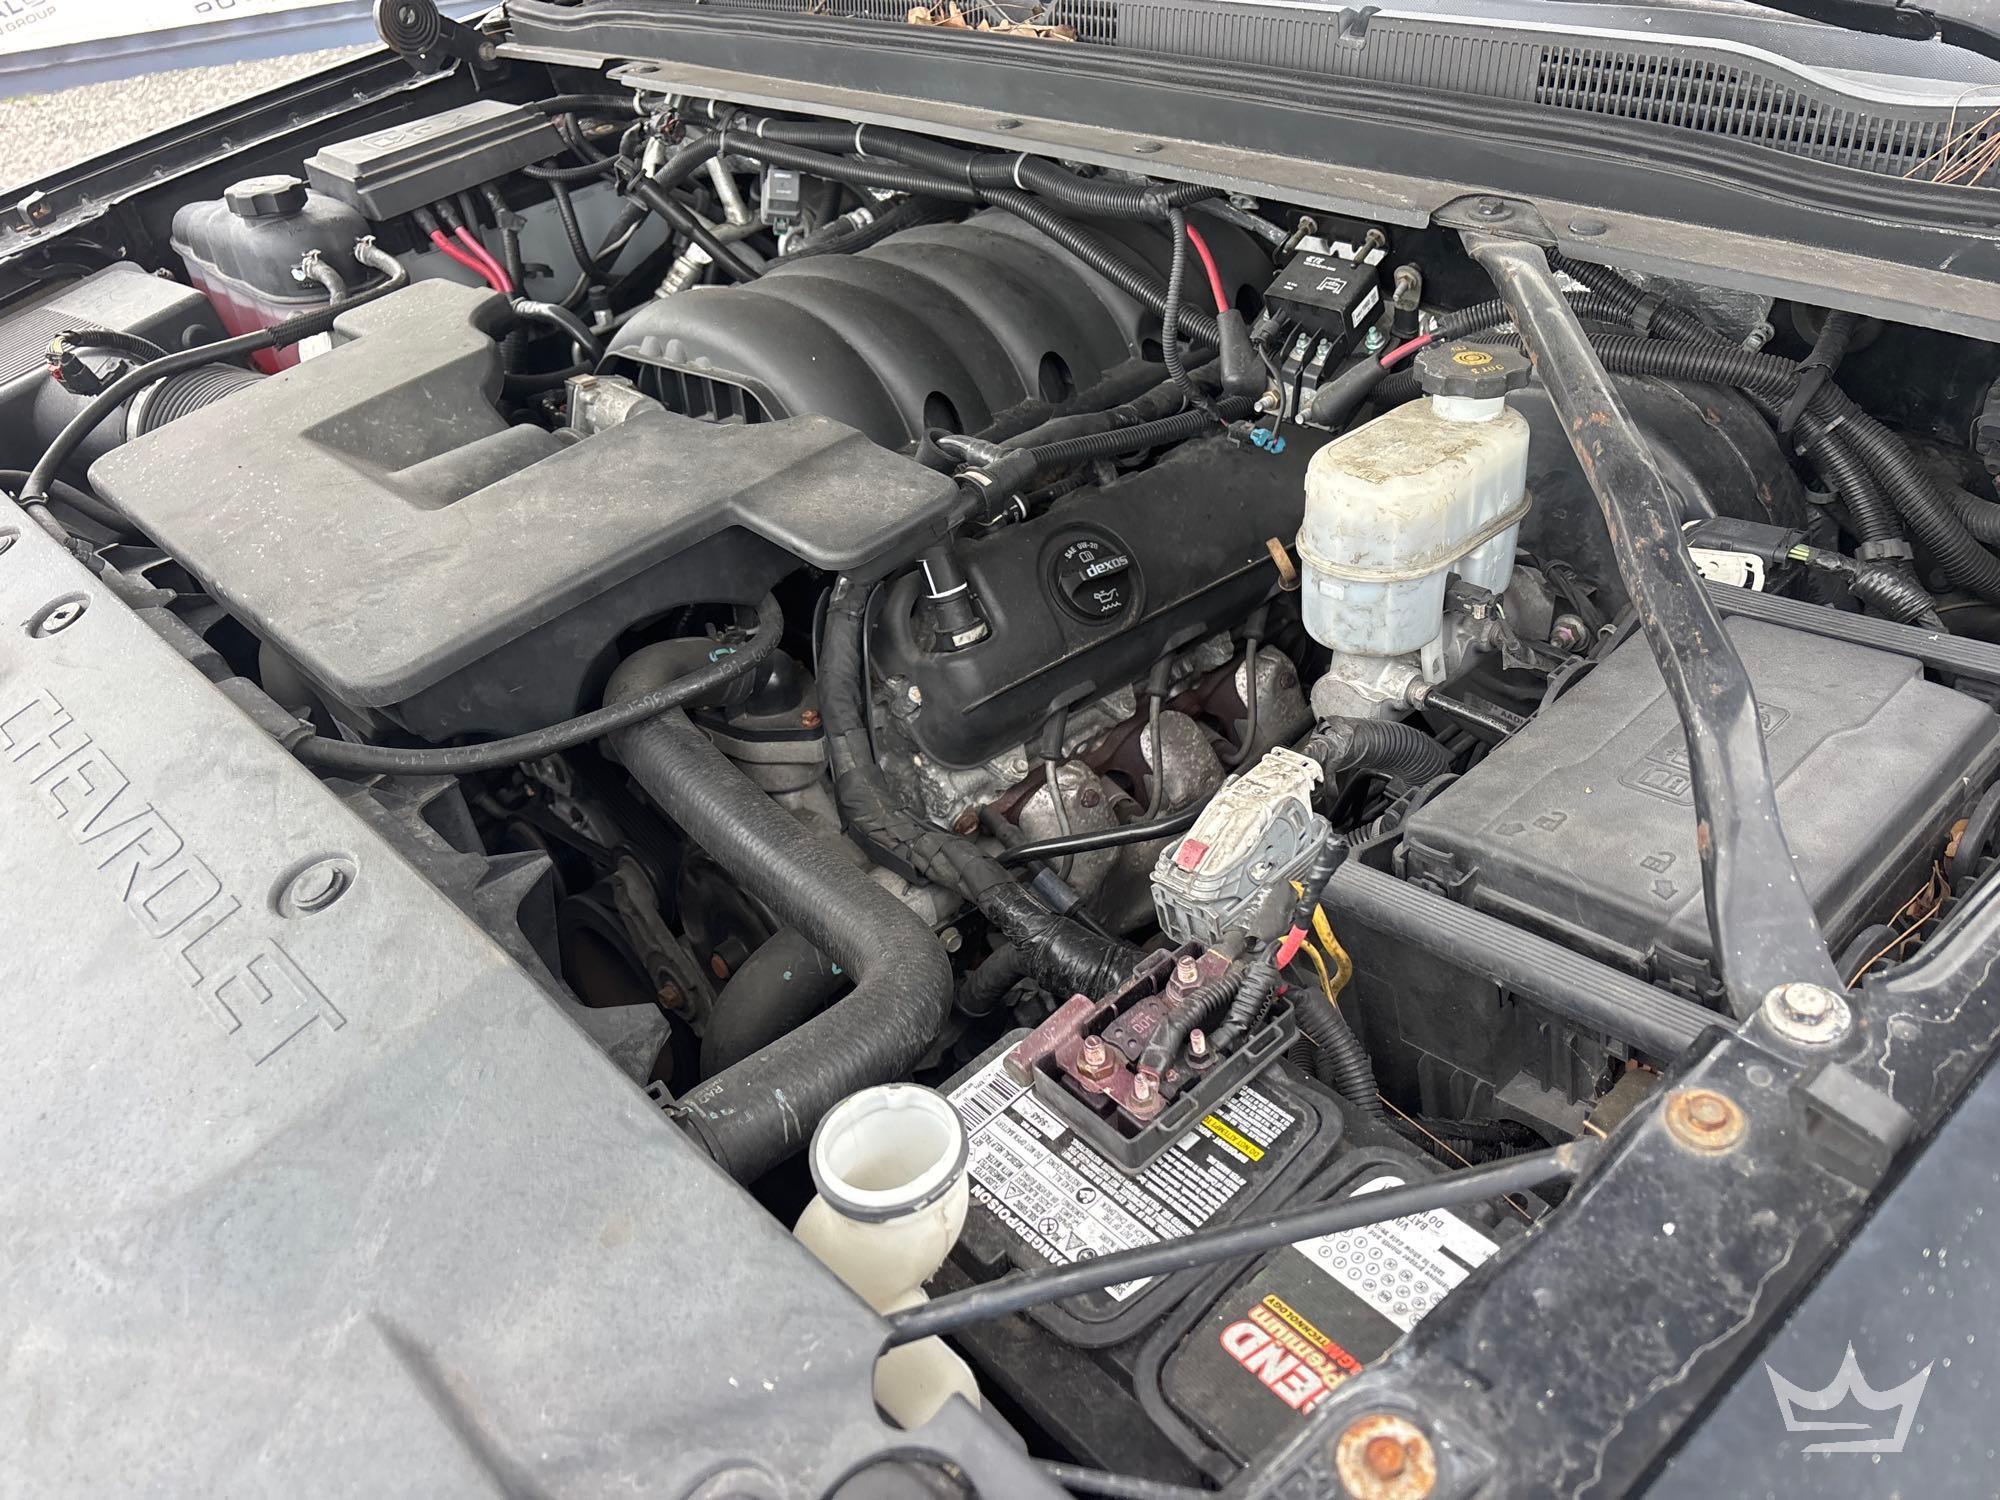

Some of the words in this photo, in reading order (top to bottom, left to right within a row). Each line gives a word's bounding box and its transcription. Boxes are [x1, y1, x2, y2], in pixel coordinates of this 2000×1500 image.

[5, 6, 56, 32] GROUP
[1064, 545, 1078, 559] SAE
[1086, 555, 1129, 578] dexos
[0, 687, 348, 1068] CHEVROLET
[1027, 1125, 1042, 1139] PART
[1210, 1120, 1239, 1142] ATTEMPT
[971, 1135, 984, 1147] GET
[990, 1140, 1005, 1153] HELP
[1012, 1133, 1027, 1146] OPEN
[1234, 1138, 1251, 1151] NOT
[1023, 1142, 1036, 1154] NOT
[1032, 1150, 1043, 1159] DO
[1066, 1144, 1080, 1155] FOR
[1212, 1135, 1249, 1163] IMPORTANT
[1247, 1147, 1260, 1158] DO
[1001, 1149, 1024, 1170] MEDICAL
[972, 1165, 987, 1179] EYES
[975, 1157, 1007, 1184] IMMEDIATELY
[999, 1164, 1014, 1178] WITH
[1051, 1172, 1063, 1183] ALL
[1195, 1167, 1218, 1186] California
[1206, 1165, 1226, 1182] HANDS
[983, 1175, 1001, 1190] FLUSH
[1092, 1175, 1103, 1184] OR
[1107, 1177, 1121, 1188] NOT
[1222, 1176, 1240, 1192] WASH
[1227, 1170, 1247, 1187] AFTER
[1060, 1179, 1075, 1193] READ
[1099, 1181, 1127, 1204] EXPLOSION
[1122, 1179, 1144, 1197] PROPER
[1163, 1184, 1182, 1200] related
[1219, 1184, 1234, 1198] State
[1139, 1193, 1162, 1212] FOLLOW
[1197, 1189, 1222, 1209] California
[1011, 1198, 1039, 1222] SULFURIC
[1031, 1201, 1046, 1215] ACID
[1135, 1210, 1145, 1218] OF
[1169, 1200, 1203, 1228] PROPOSITION
[1100, 1212, 1115, 1225] THE
[1142, 1215, 1157, 1227] RISK
[1428, 1214, 1444, 1228] DO
[1367, 1228, 1382, 1241] and
[1387, 1233, 1404, 1247] date
[1380, 1238, 1403, 1256] month
[1402, 1244, 1422, 1260] show
[1400, 1251, 1425, 1272] proper
[1420, 1257, 1430, 1265] to
[1428, 1262, 1445, 1277] tabs
[1266, 1297, 1328, 1344] TECHNOLOGY
[1248, 1303, 1348, 1391] Premium
